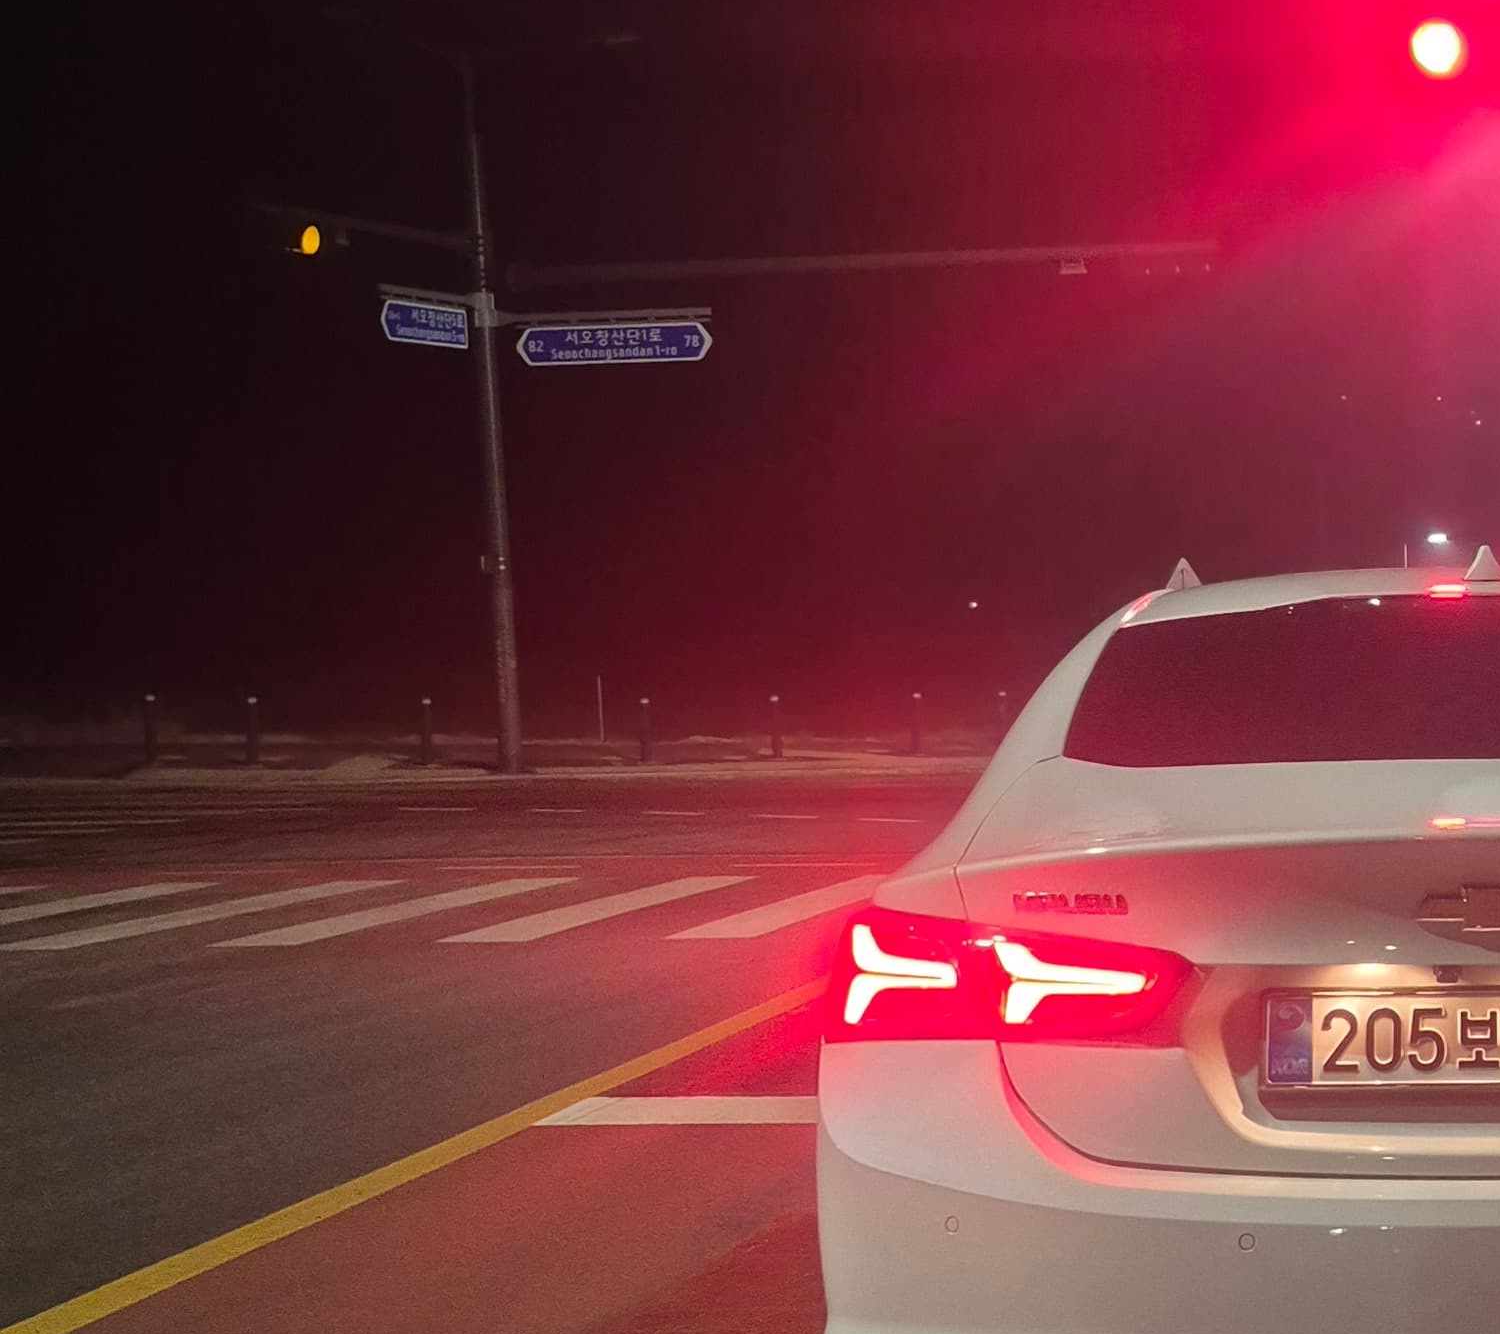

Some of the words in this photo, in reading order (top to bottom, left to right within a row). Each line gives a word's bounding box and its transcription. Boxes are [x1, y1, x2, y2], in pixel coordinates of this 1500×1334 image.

[565, 328, 663, 346] 서오창산단1로
[684, 335, 700, 348] 78
[528, 340, 544, 353] 82
